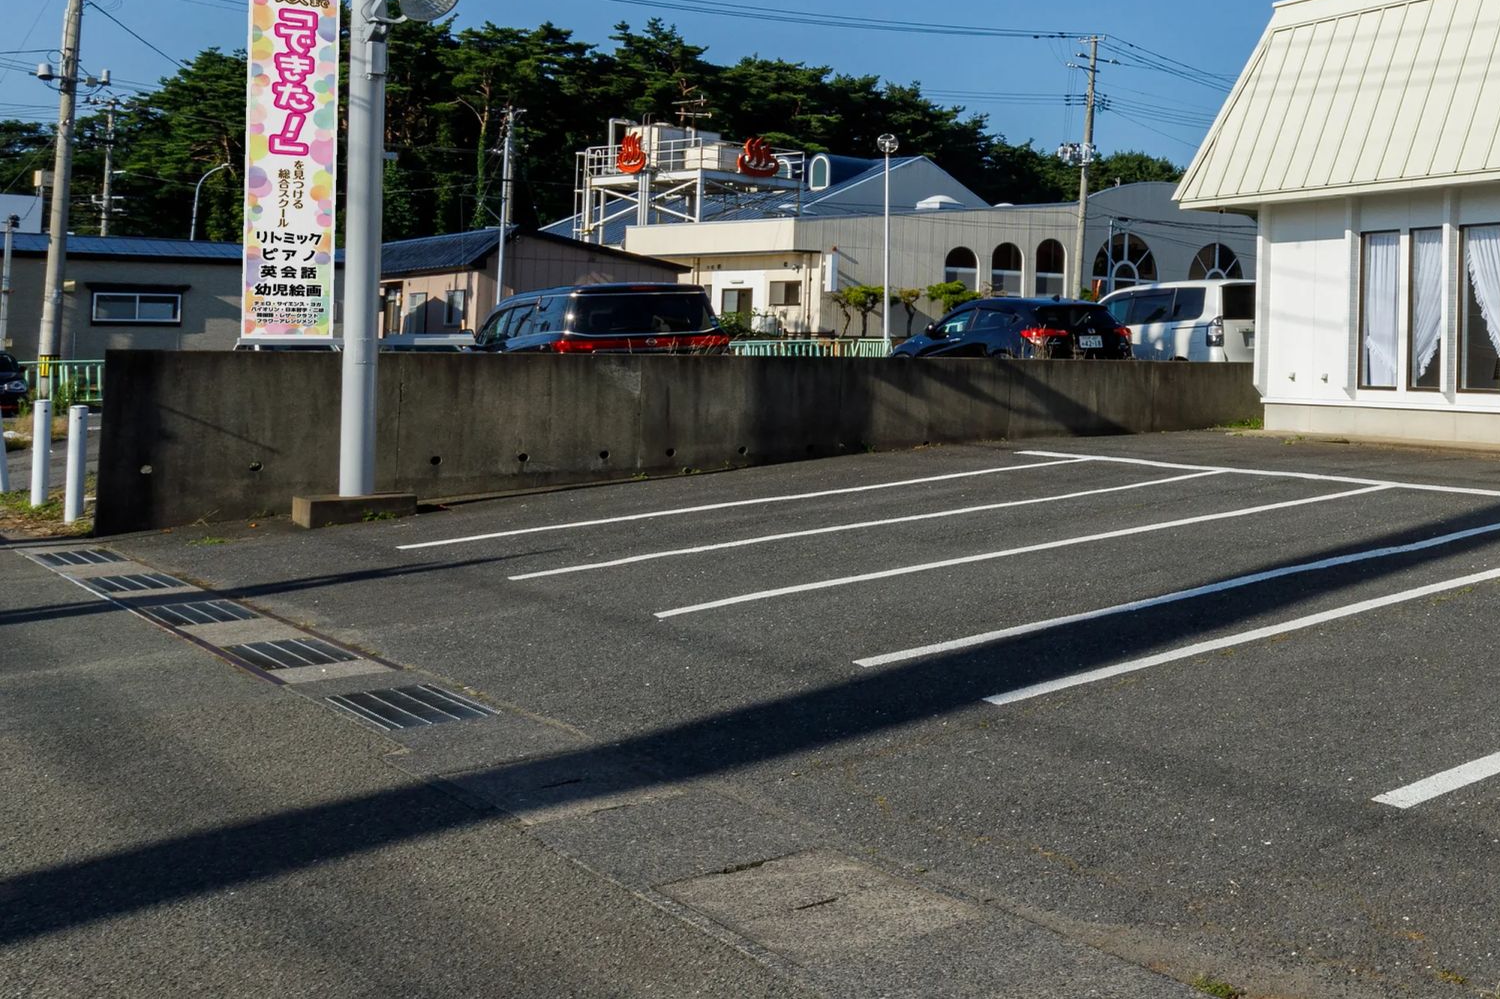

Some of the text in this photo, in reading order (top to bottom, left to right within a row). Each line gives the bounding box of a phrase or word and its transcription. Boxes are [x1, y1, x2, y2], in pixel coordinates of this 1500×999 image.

[292, 160, 305, 210] を見つける
[277, 168, 291, 228] 総合スクール
[256, 231, 322, 246] リトミック
[262, 249, 316, 261] ピアノ
[260, 265, 317, 280] 英会話
[254, 283, 322, 298] 幼児絵画
